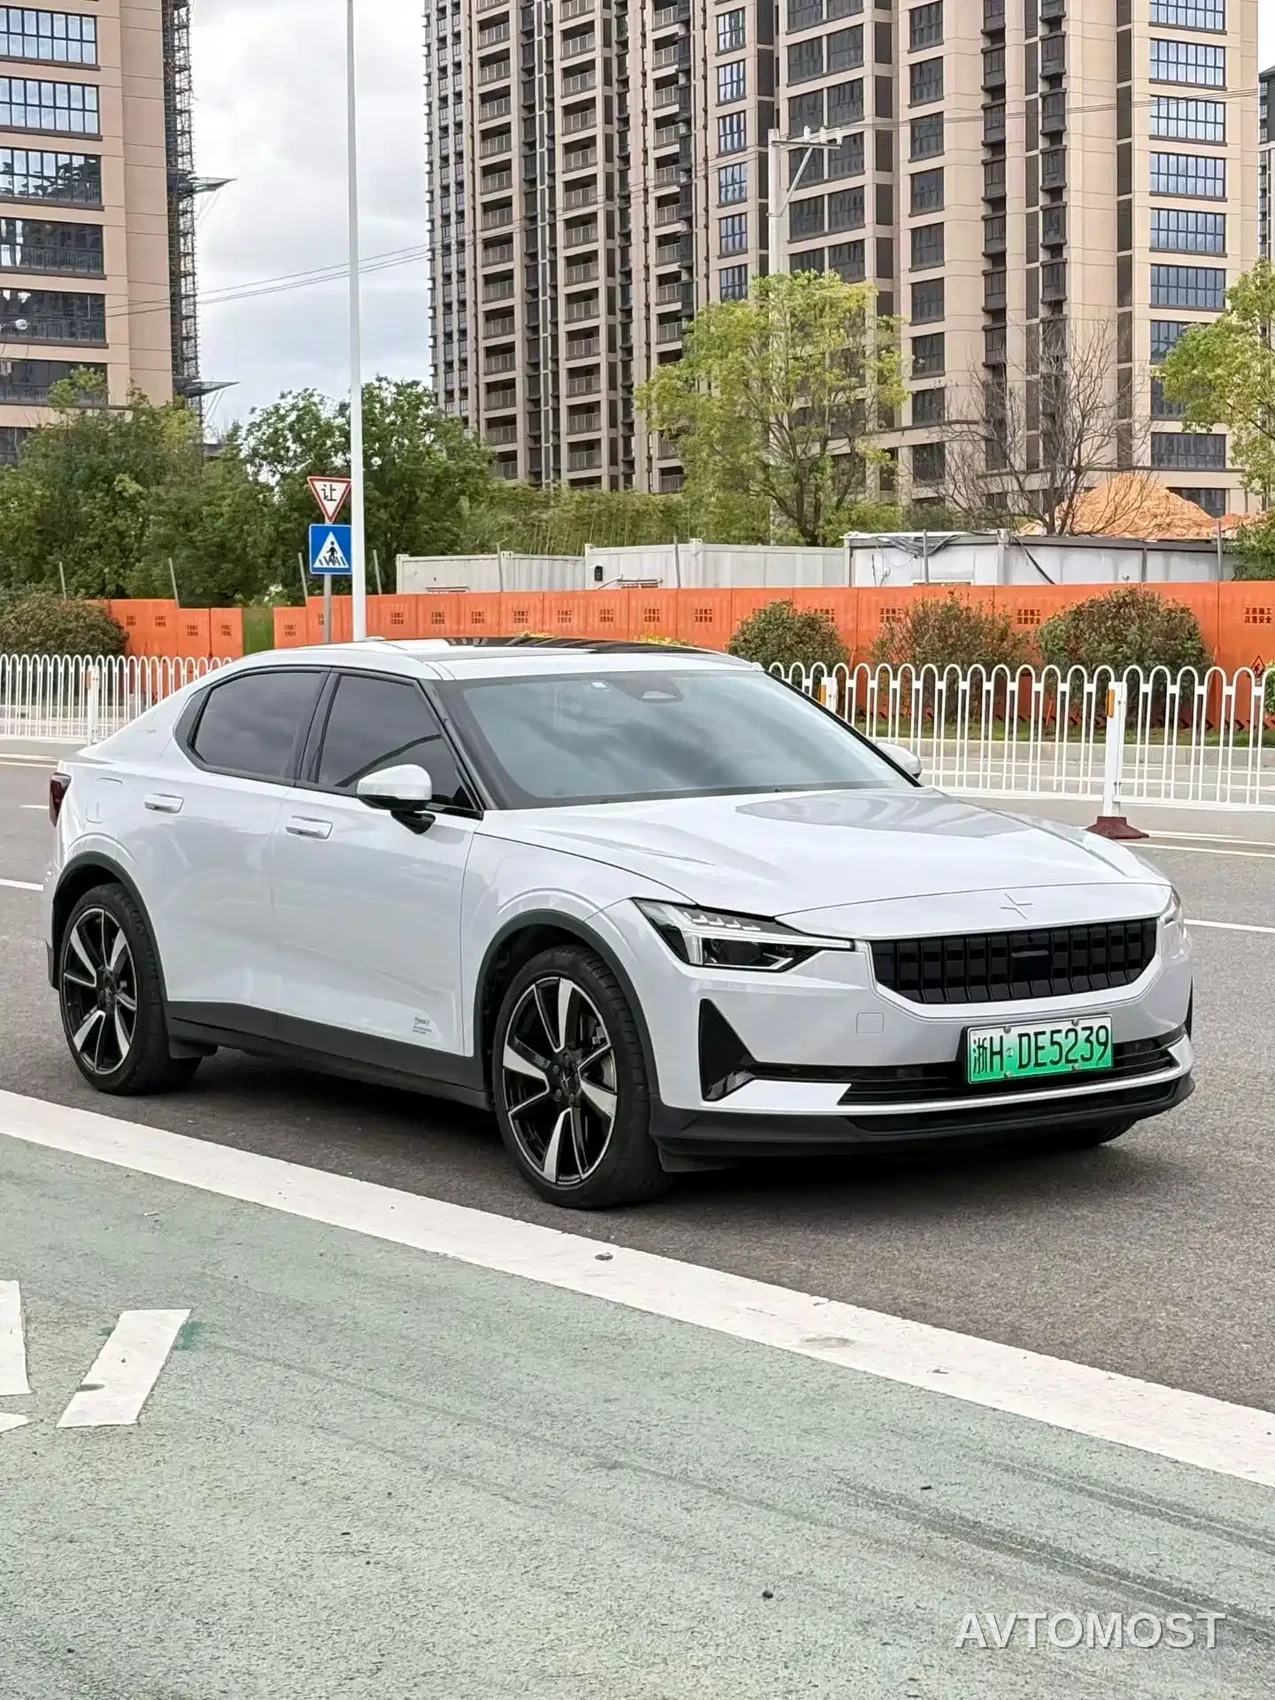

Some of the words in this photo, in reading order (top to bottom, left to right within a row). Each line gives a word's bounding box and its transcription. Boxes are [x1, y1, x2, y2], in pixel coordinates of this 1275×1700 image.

[320, 483, 338, 502] 让
[1017, 608, 1041, 616] 正在施工
[1244, 607, 1272, 615] 正在施工
[1244, 616, 1272, 624] 注意安全
[1017, 1025, 1109, 1070] DE5239
